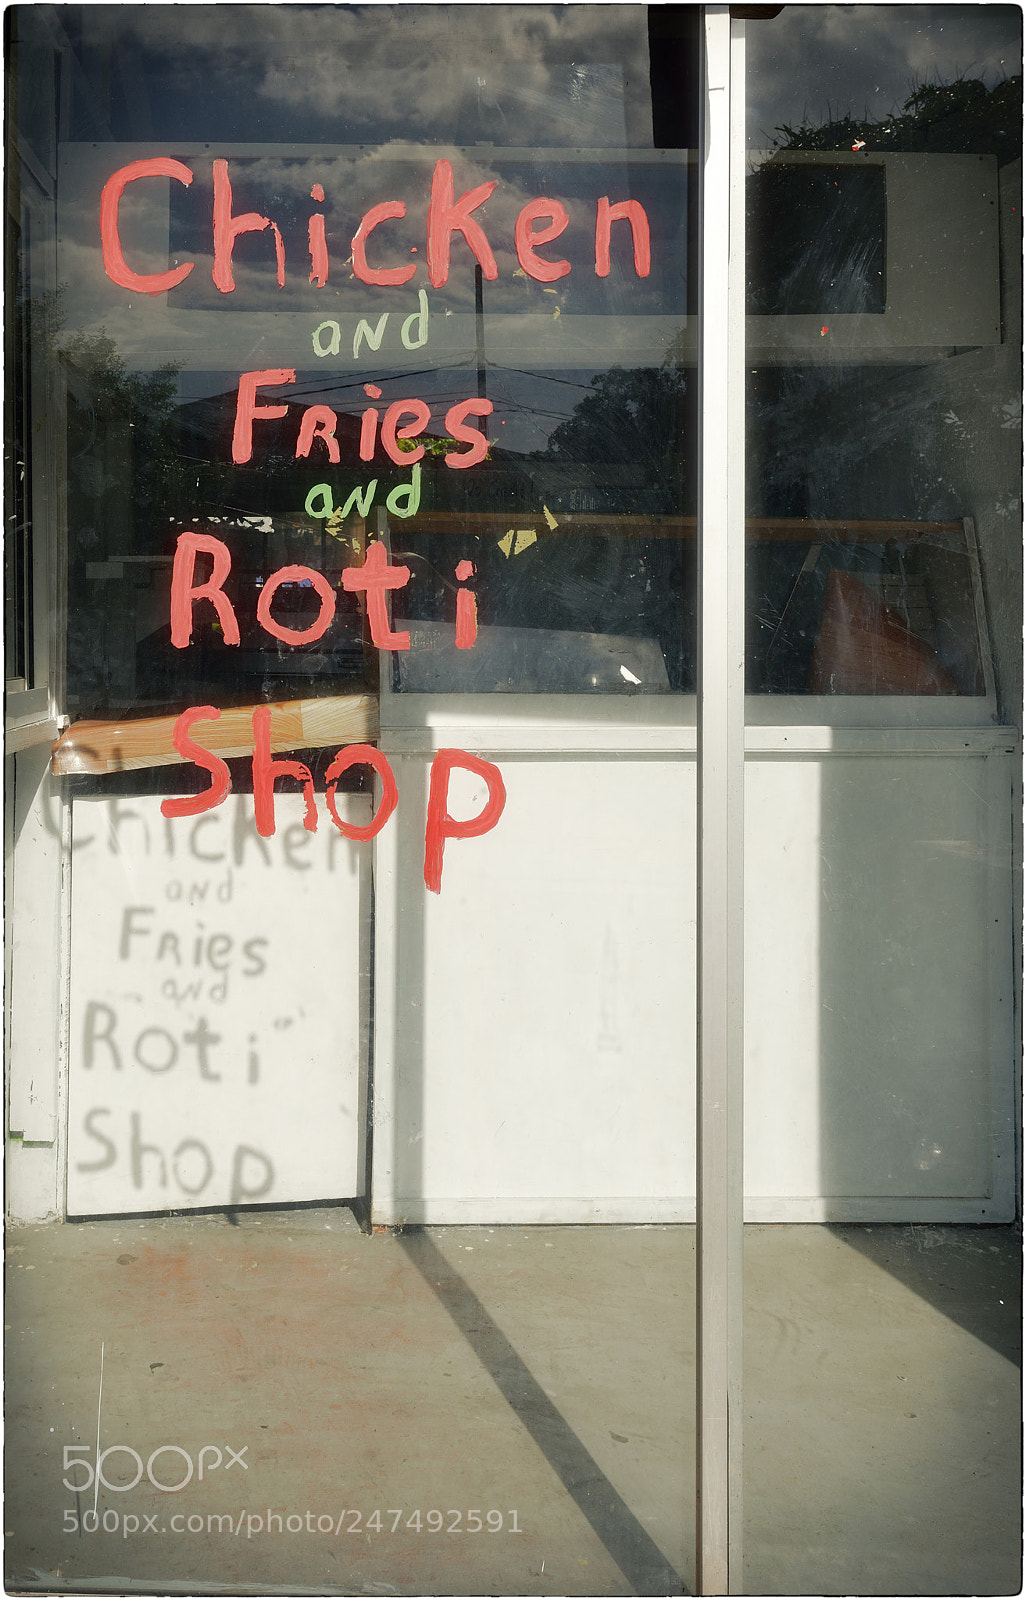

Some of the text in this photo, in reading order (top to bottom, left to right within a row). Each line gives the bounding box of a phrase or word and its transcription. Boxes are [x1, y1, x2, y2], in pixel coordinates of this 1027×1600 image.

[100, 156, 651, 294] Chicken
[170, 531, 478, 650] Roti
[161, 704, 507, 895] Shop
[80, 998, 263, 1086] Roti
[76, 1106, 277, 1206] Shop
